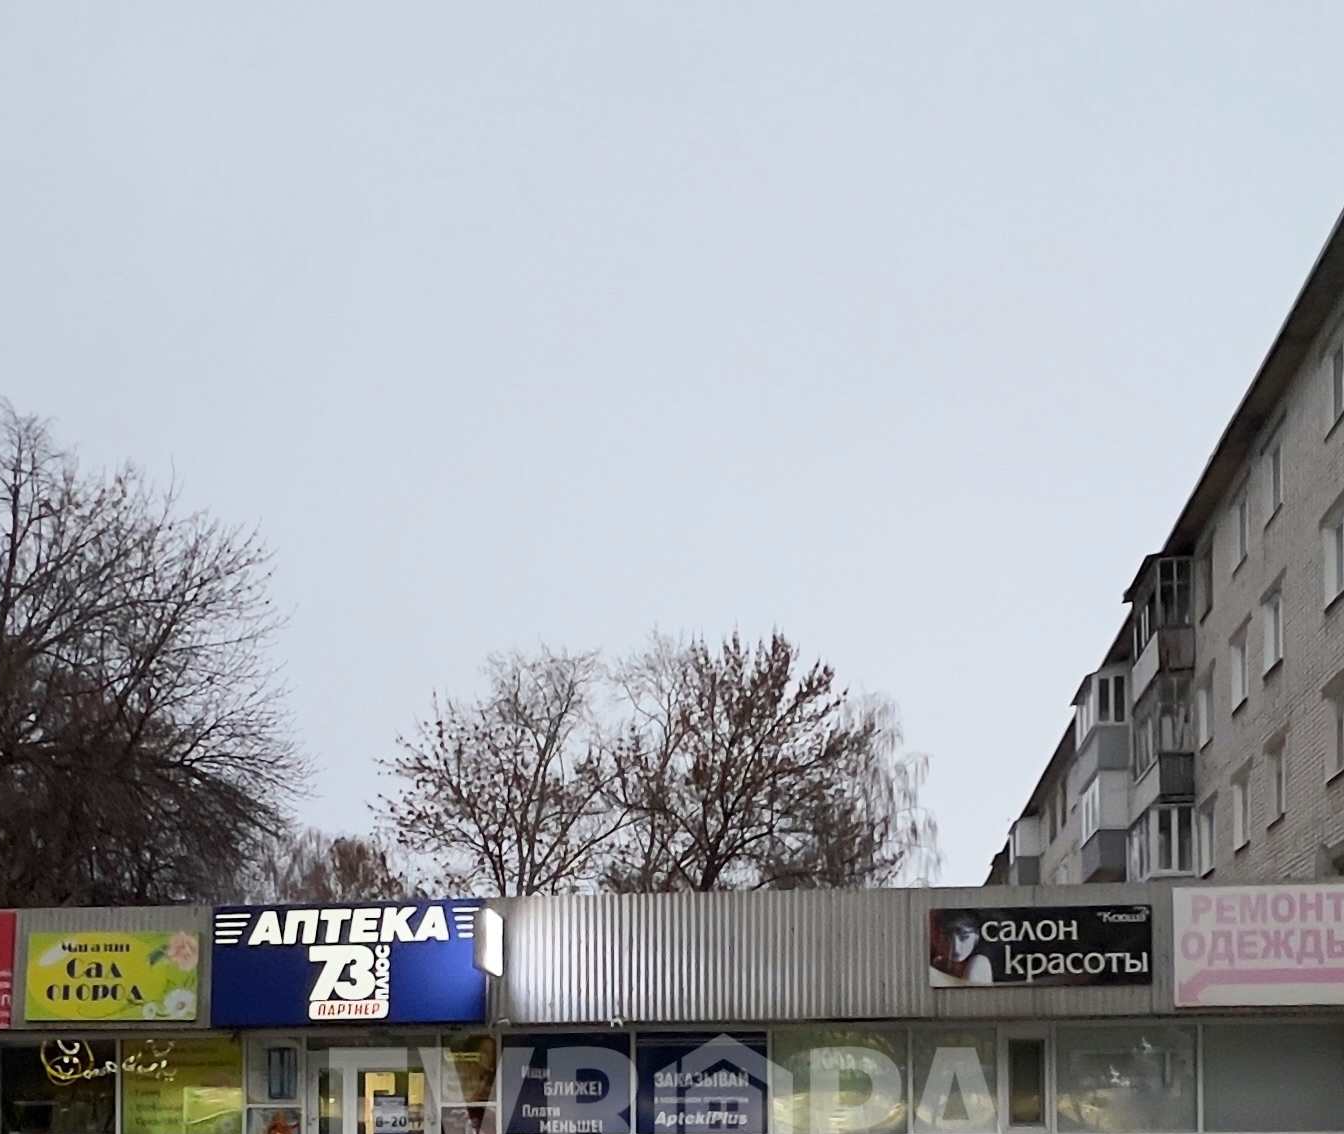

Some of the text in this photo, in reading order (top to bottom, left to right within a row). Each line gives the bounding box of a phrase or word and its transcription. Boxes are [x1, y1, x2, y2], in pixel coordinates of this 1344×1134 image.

[248, 906, 450, 945] АПТЕКА
[981, 919, 1078, 942] салон
[309, 945, 376, 1001] 73
[1004, 944, 1149, 983] красоты
[317, 1003, 381, 1016] ПАРТНЕР
[654, 1067, 749, 1087] ЗАКАЗЫВАЙ
[543, 1081, 602, 1096] БЛИЖЕ!
[540, 1119, 603, 1133] МЕНЬШЕ!
